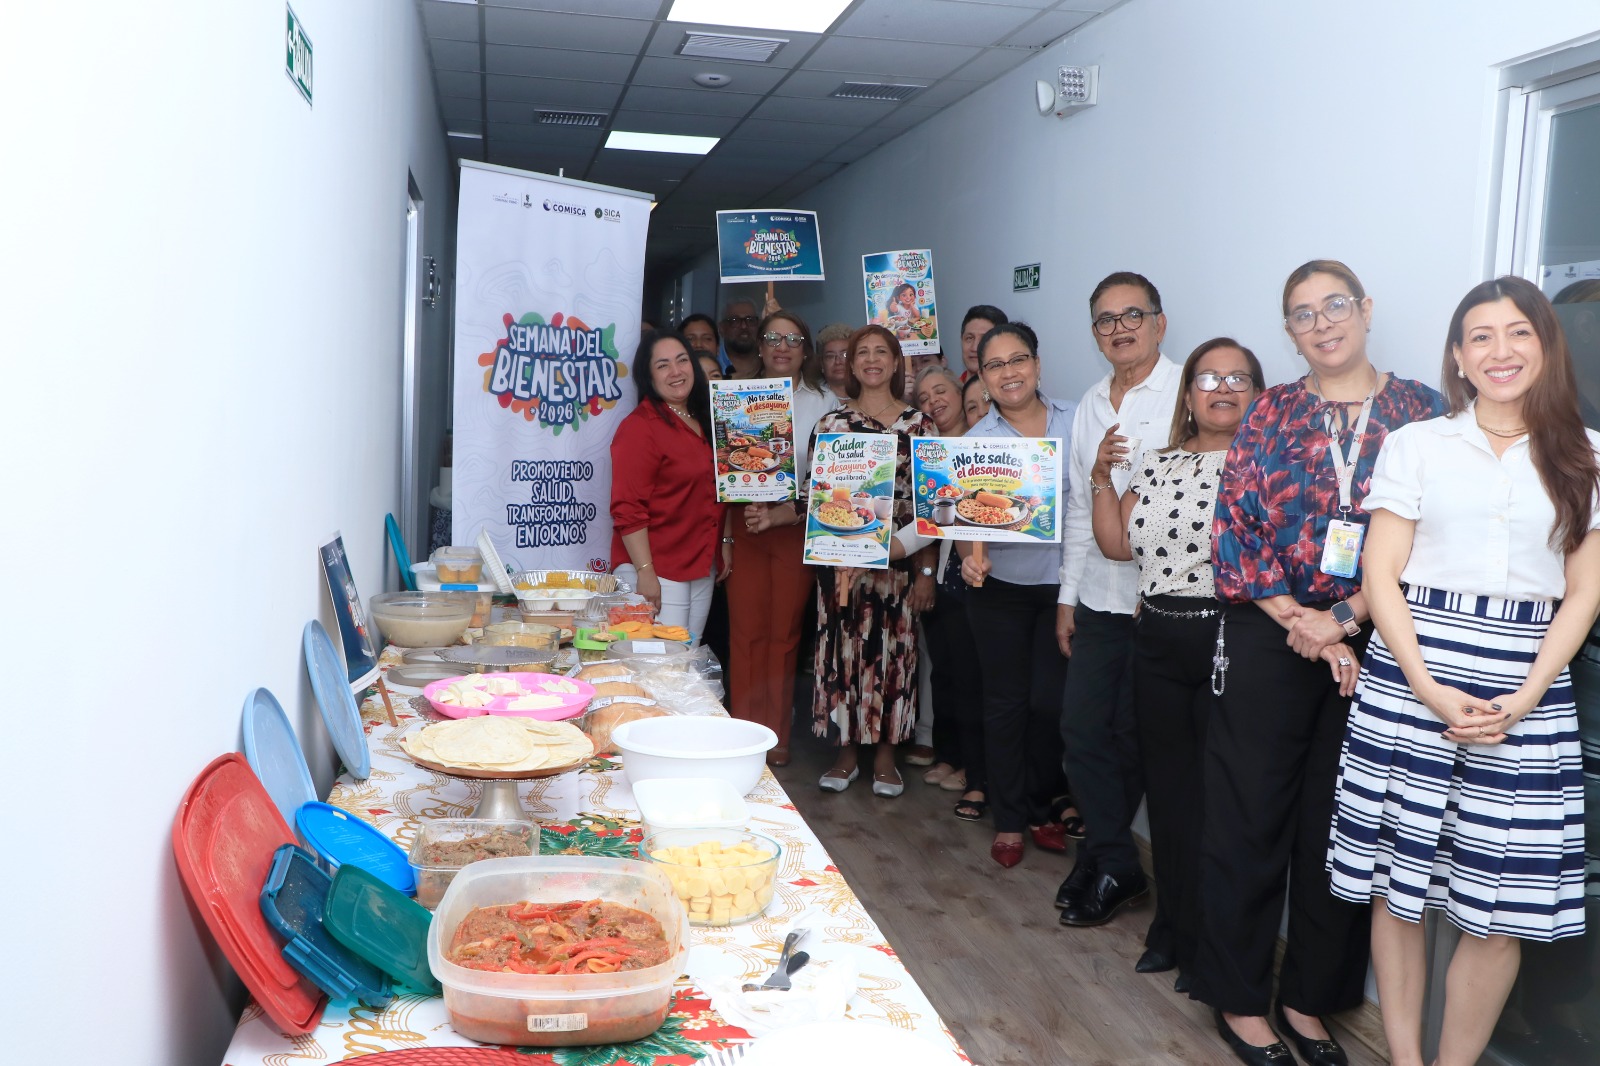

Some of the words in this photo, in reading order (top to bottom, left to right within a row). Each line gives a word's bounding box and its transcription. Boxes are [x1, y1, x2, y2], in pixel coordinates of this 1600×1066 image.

[552, 203, 587, 217] COMISCA
[603, 208, 621, 218] SICA
[754, 232, 778, 241] SEMANA
[780, 233, 791, 241] DEL
[749, 241, 798, 256] BIENESTAR
[509, 325, 572, 354] SEMANA
[576, 330, 604, 357] DEL
[491, 347, 620, 404] BIENESTAR
[766, 392, 785, 402] saltes
[540, 402, 573, 423] 2026
[746, 405, 753, 414] el
[754, 402, 790, 411] desayuno!
[832, 438, 867, 454] Cuidar
[838, 451, 845, 459] tu
[952, 453, 972, 471] ¡No
[974, 452, 985, 464] te
[987, 452, 1024, 468] saltes
[827, 462, 867, 475] desayuno
[956, 467, 967, 479] el
[967, 463, 1023, 480] desayuno!
[532, 481, 577, 504] SALUD,
[507, 503, 596, 525] TRANSFORMANDO
[516, 522, 587, 548] ENTORNOS
